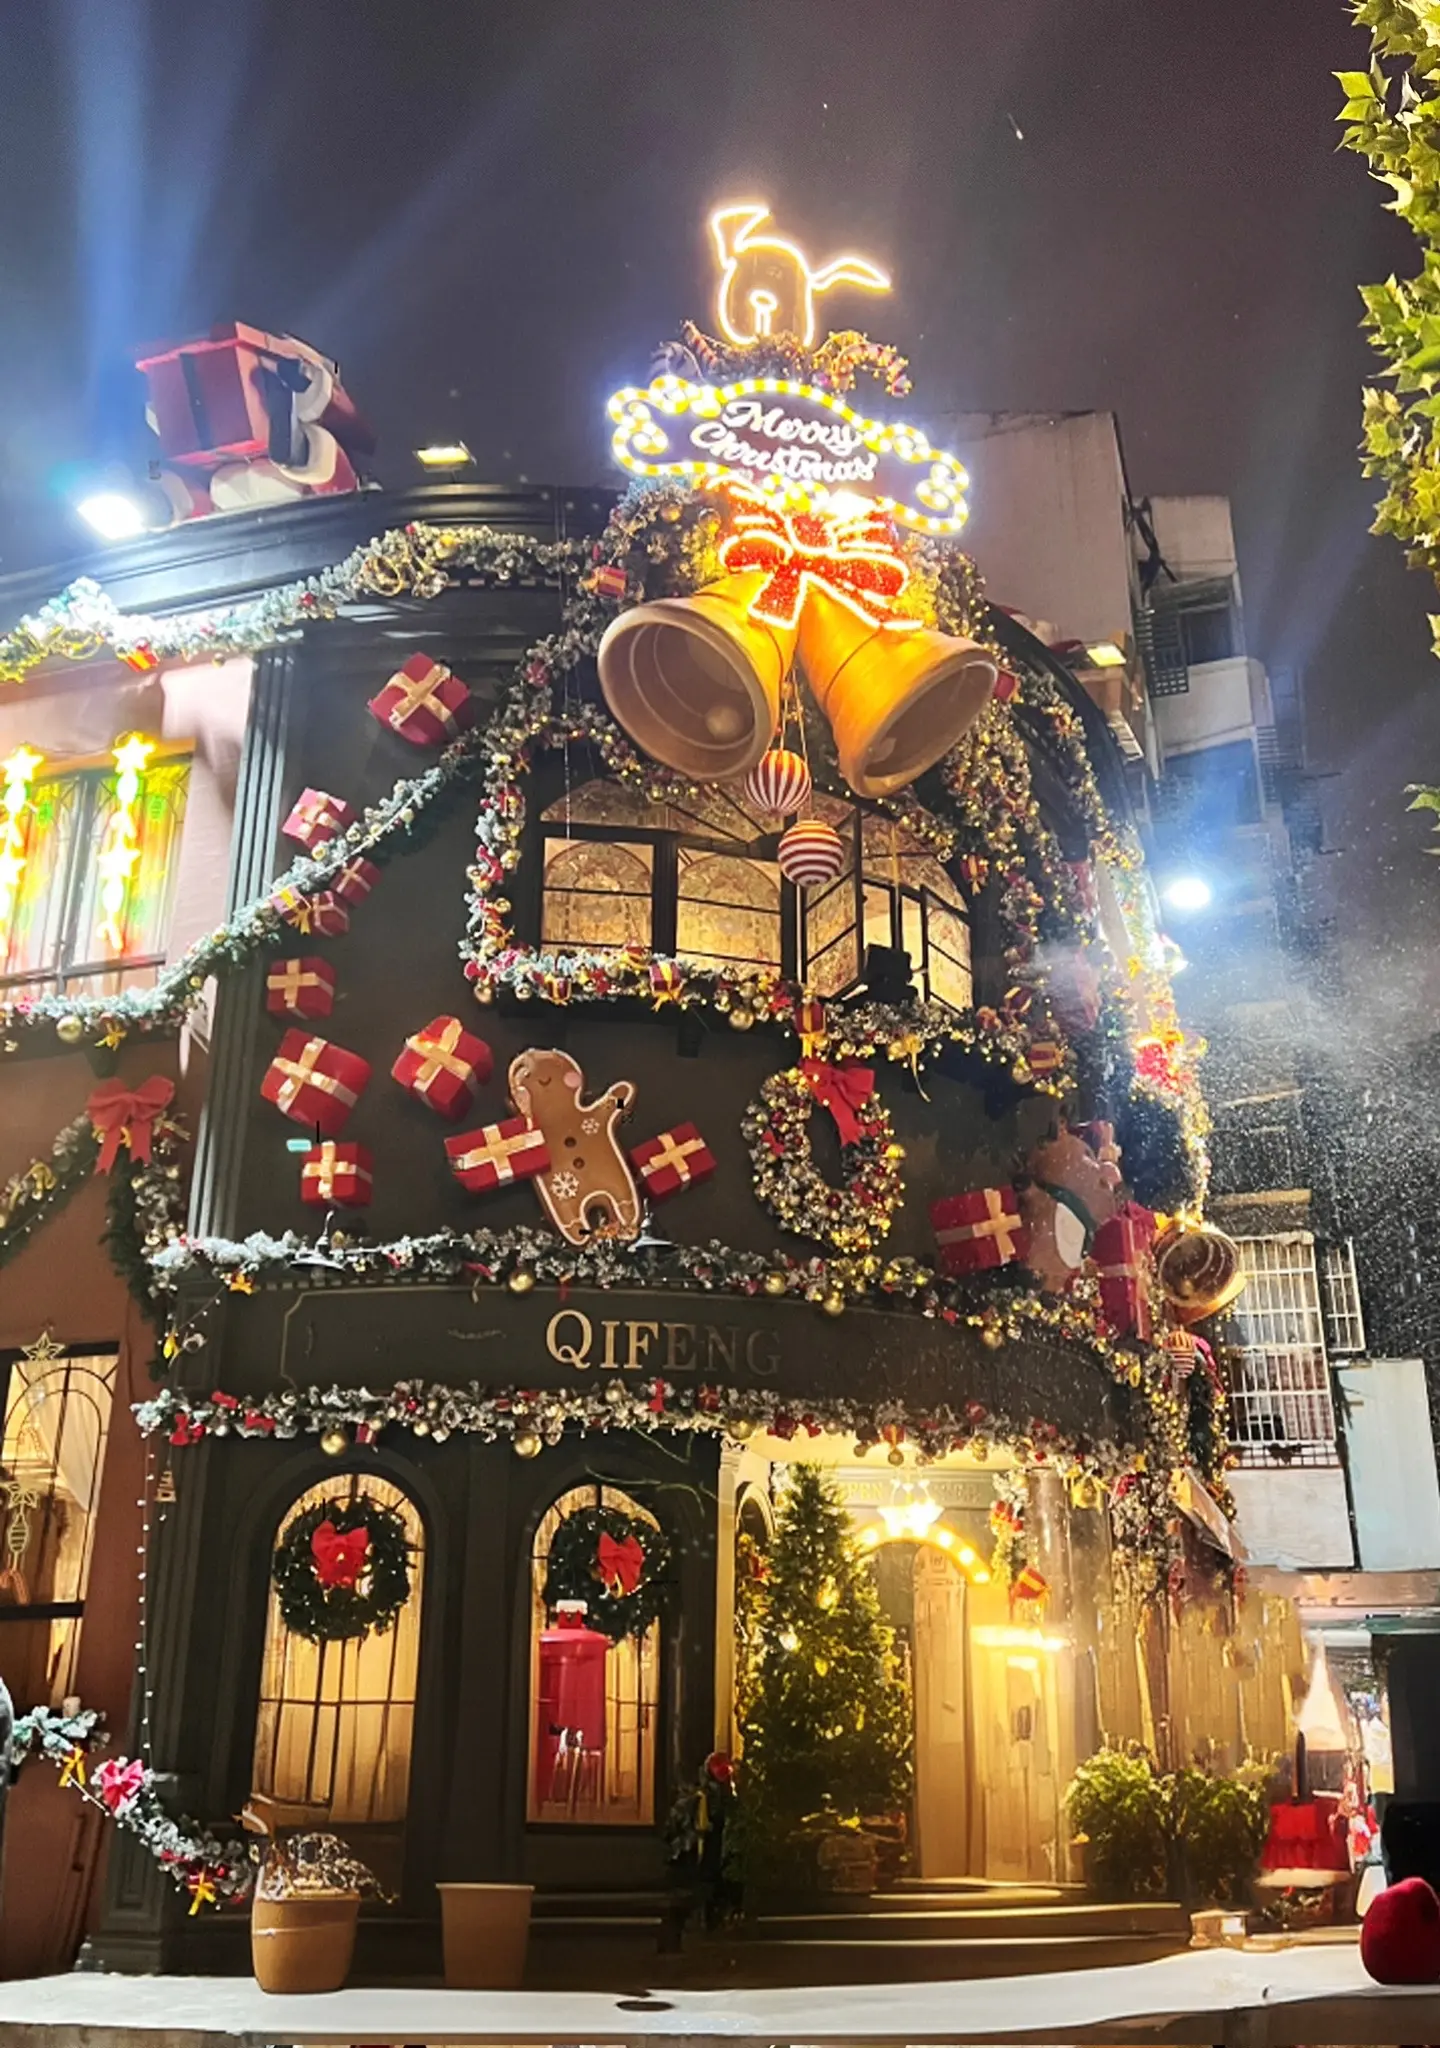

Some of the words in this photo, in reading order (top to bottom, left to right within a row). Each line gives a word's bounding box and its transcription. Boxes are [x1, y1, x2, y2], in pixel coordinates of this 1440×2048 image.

[690, 421, 878, 482] Christmas
[721, 401, 864, 457] Merry
[546, 1309, 782, 1376] QIFENG
